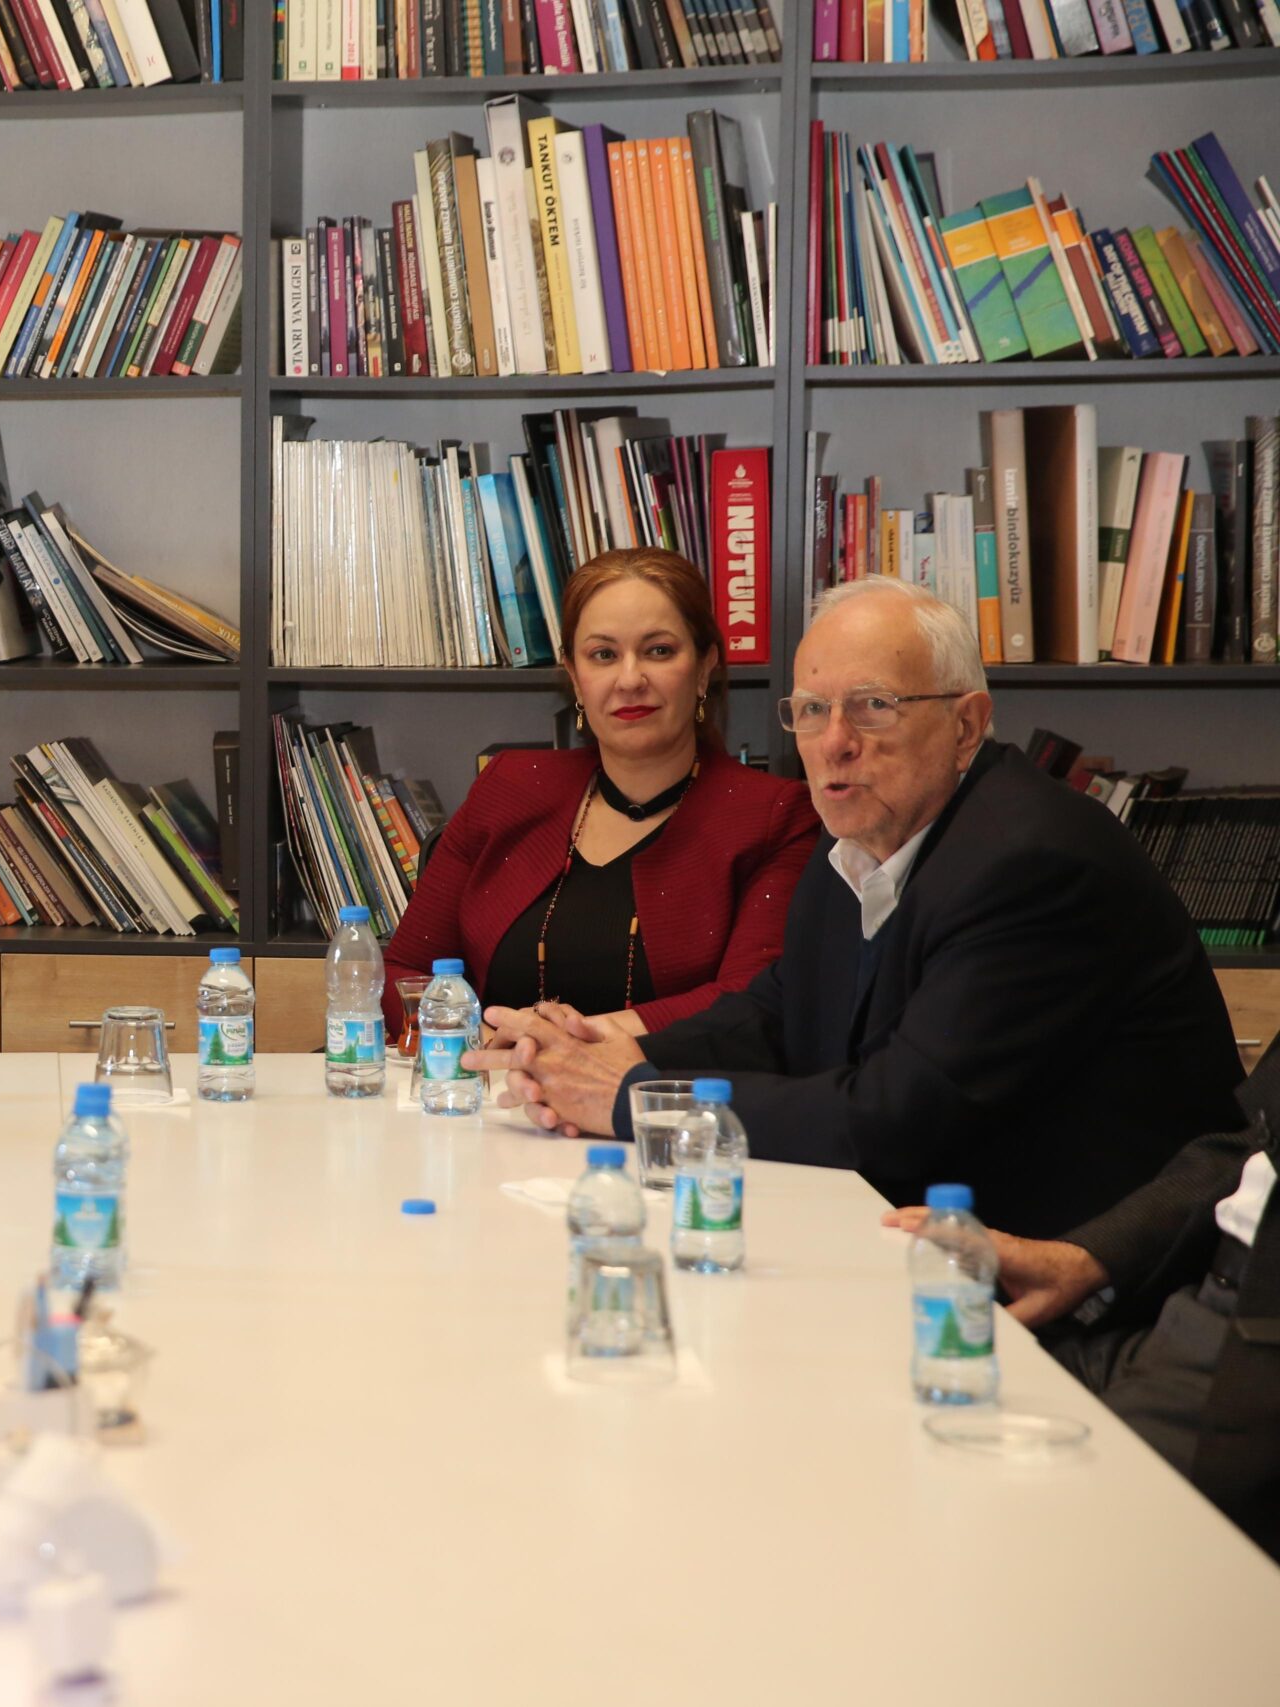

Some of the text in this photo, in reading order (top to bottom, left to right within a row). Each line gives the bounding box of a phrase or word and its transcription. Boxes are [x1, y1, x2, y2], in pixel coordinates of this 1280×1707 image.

[536, 134, 562, 247] TANKUT ÖKTEM
[406, 251, 419, 287] RÖNESANS
[435, 169, 463, 334] TÜRKİYE CUMHURİYET MERKEZ BANKASI
[1101, 242, 1119, 264] DAY
[1109, 260, 1124, 276] OF
[290, 264, 302, 365] TANRI YANILGISI
[8, 550, 30, 579] MAVİ
[20, 576, 37, 594] AY
[725, 504, 756, 626] NUTUK
[1258, 525, 1273, 581] CUMHURİYET
